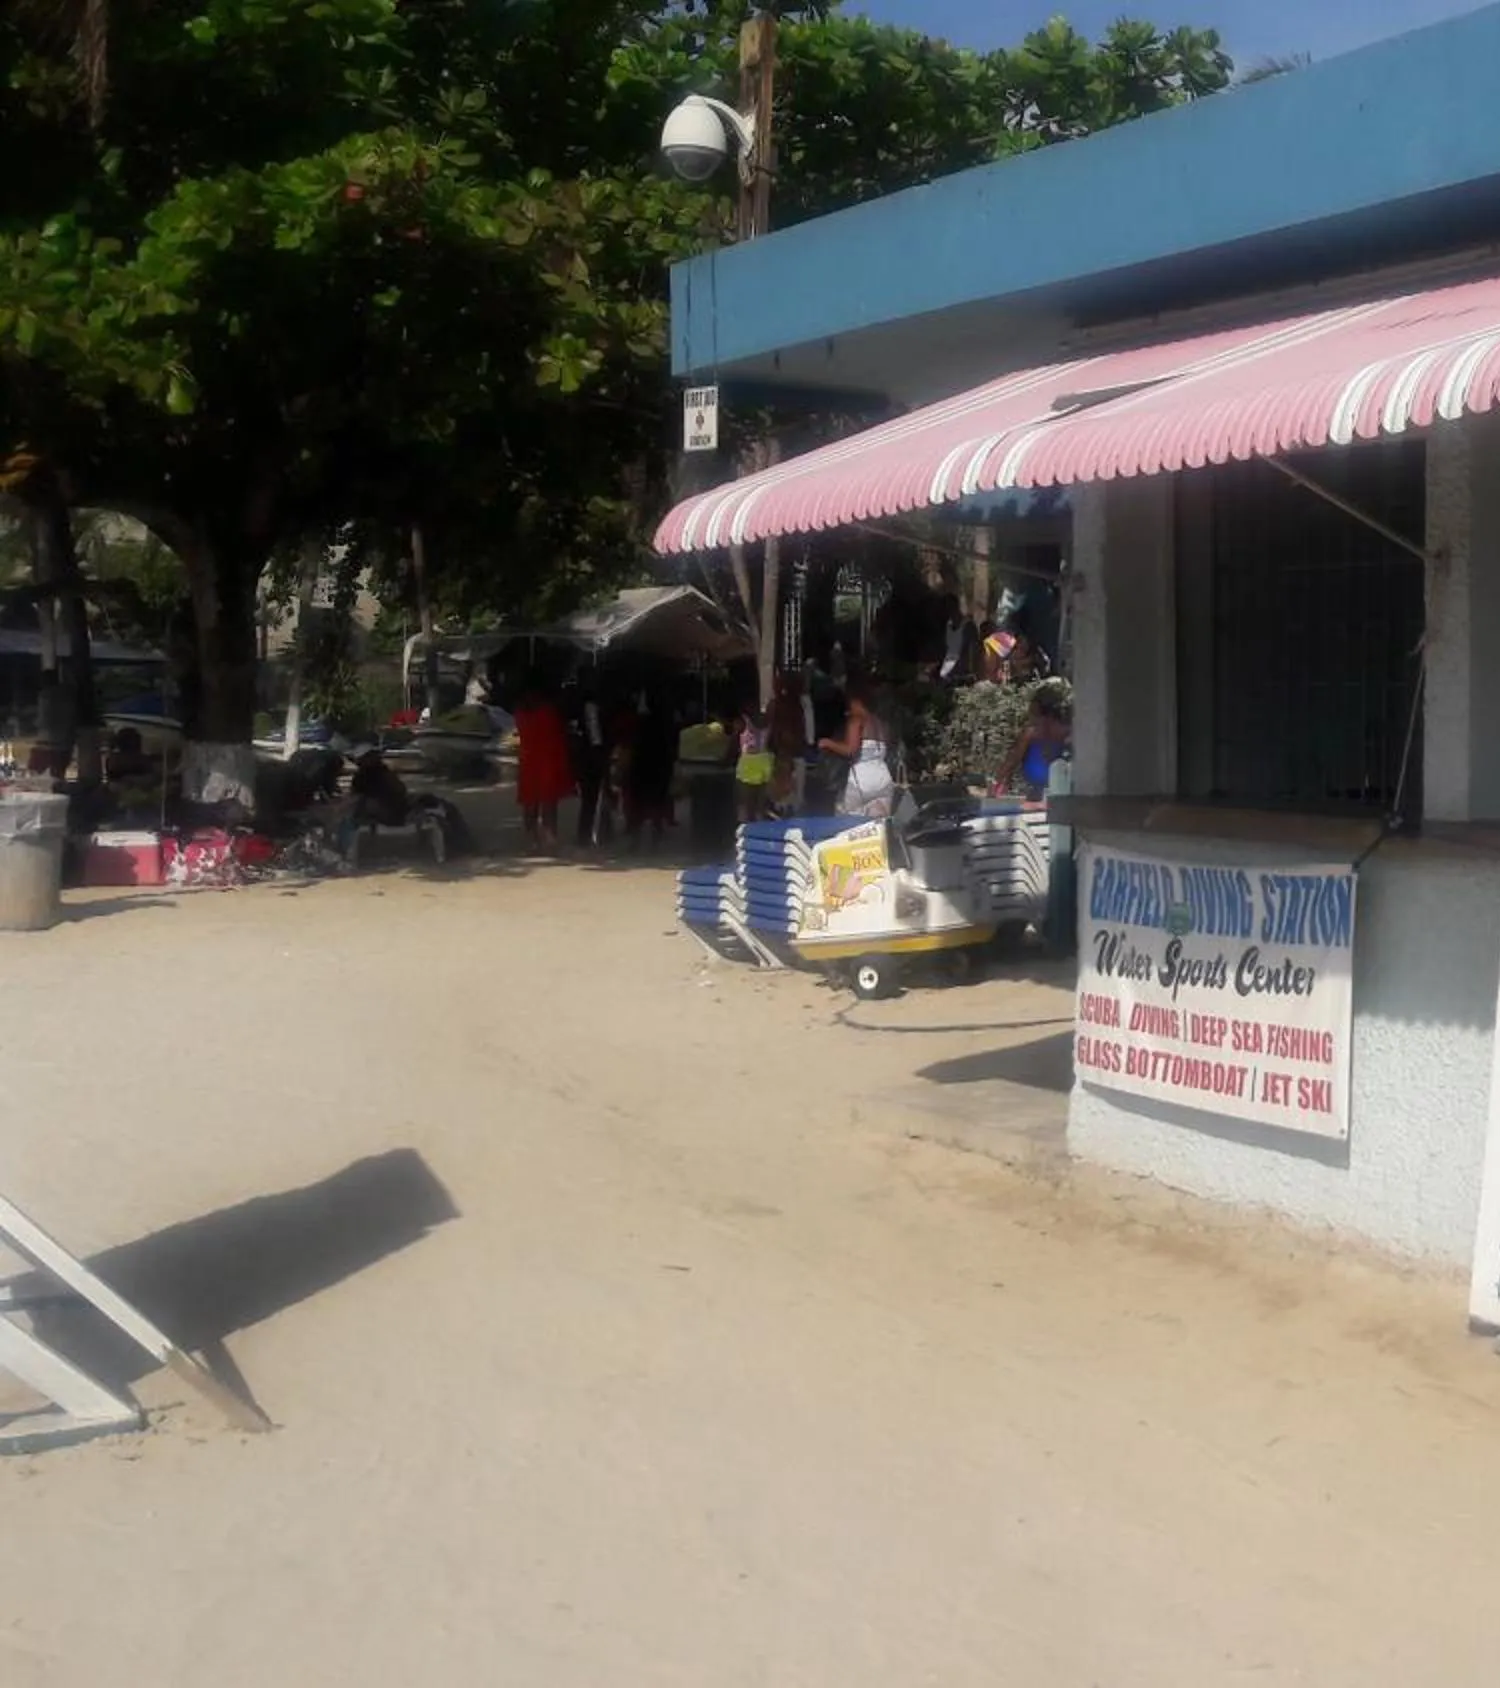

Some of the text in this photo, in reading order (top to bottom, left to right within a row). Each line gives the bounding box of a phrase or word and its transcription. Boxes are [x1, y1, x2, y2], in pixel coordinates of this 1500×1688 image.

[1178, 865, 1253, 938] DIVING
[1260, 873, 1352, 947] STATION
[1093, 929, 1316, 1002] Water Sports Center
[1080, 992, 1333, 1064] SCUBA DIVING DEEP SEA FISHING
[1077, 1036, 1121, 1073] GLASS
[1261, 1072, 1292, 1105] JET
[1297, 1077, 1333, 1113] SKI
